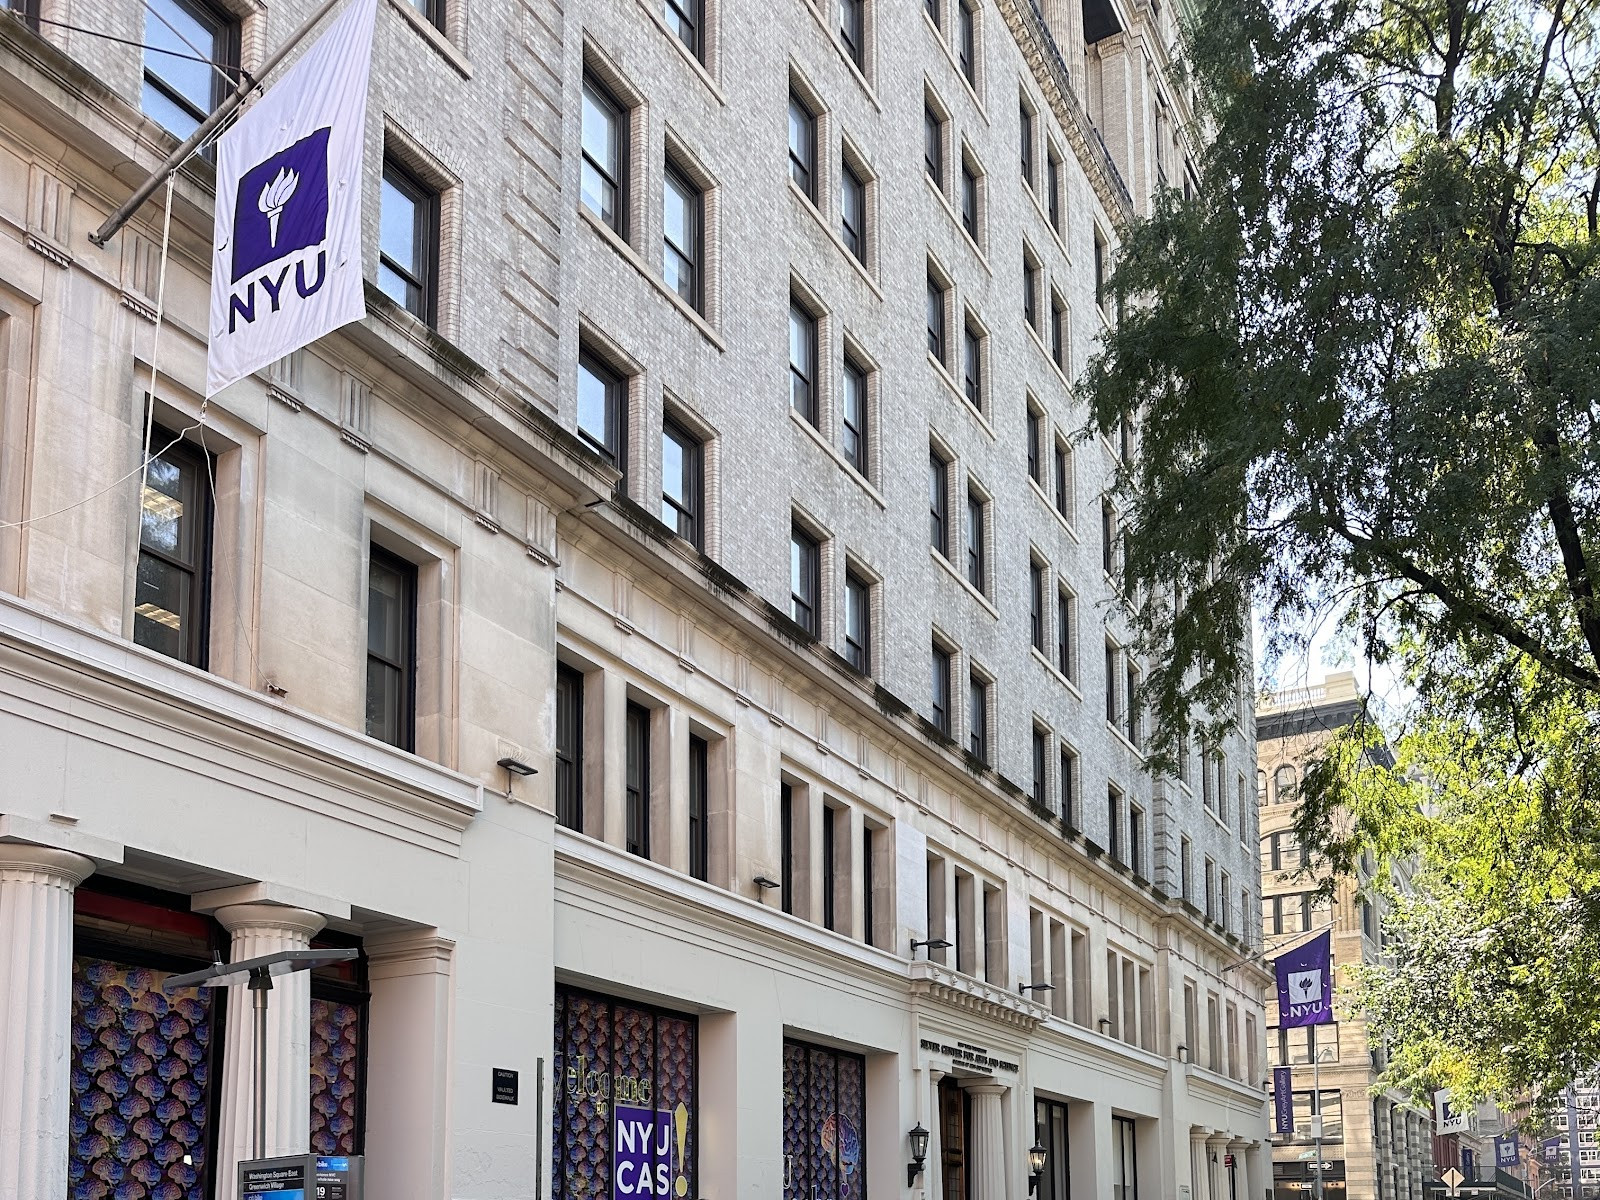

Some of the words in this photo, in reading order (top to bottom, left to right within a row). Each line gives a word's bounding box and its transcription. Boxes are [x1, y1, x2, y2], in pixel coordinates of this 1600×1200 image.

[228, 249, 326, 335] NYU
[1290, 1001, 1323, 1018] NYU
[497, 1071, 514, 1079] CAUTION
[1443, 1116, 1462, 1128] NYU
[617, 1119, 670, 1156] NYU
[1500, 1155, 1516, 1163] NYU
[249, 1172, 273, 1180] Washington
[273, 1170, 287, 1179] Square
[288, 1169, 299, 1177] East
[616, 1160, 670, 1197] CAS
[249, 1182, 271, 1190] Greenwich
[270, 1181, 285, 1190] Village
[316, 1186, 326, 1196] 19
